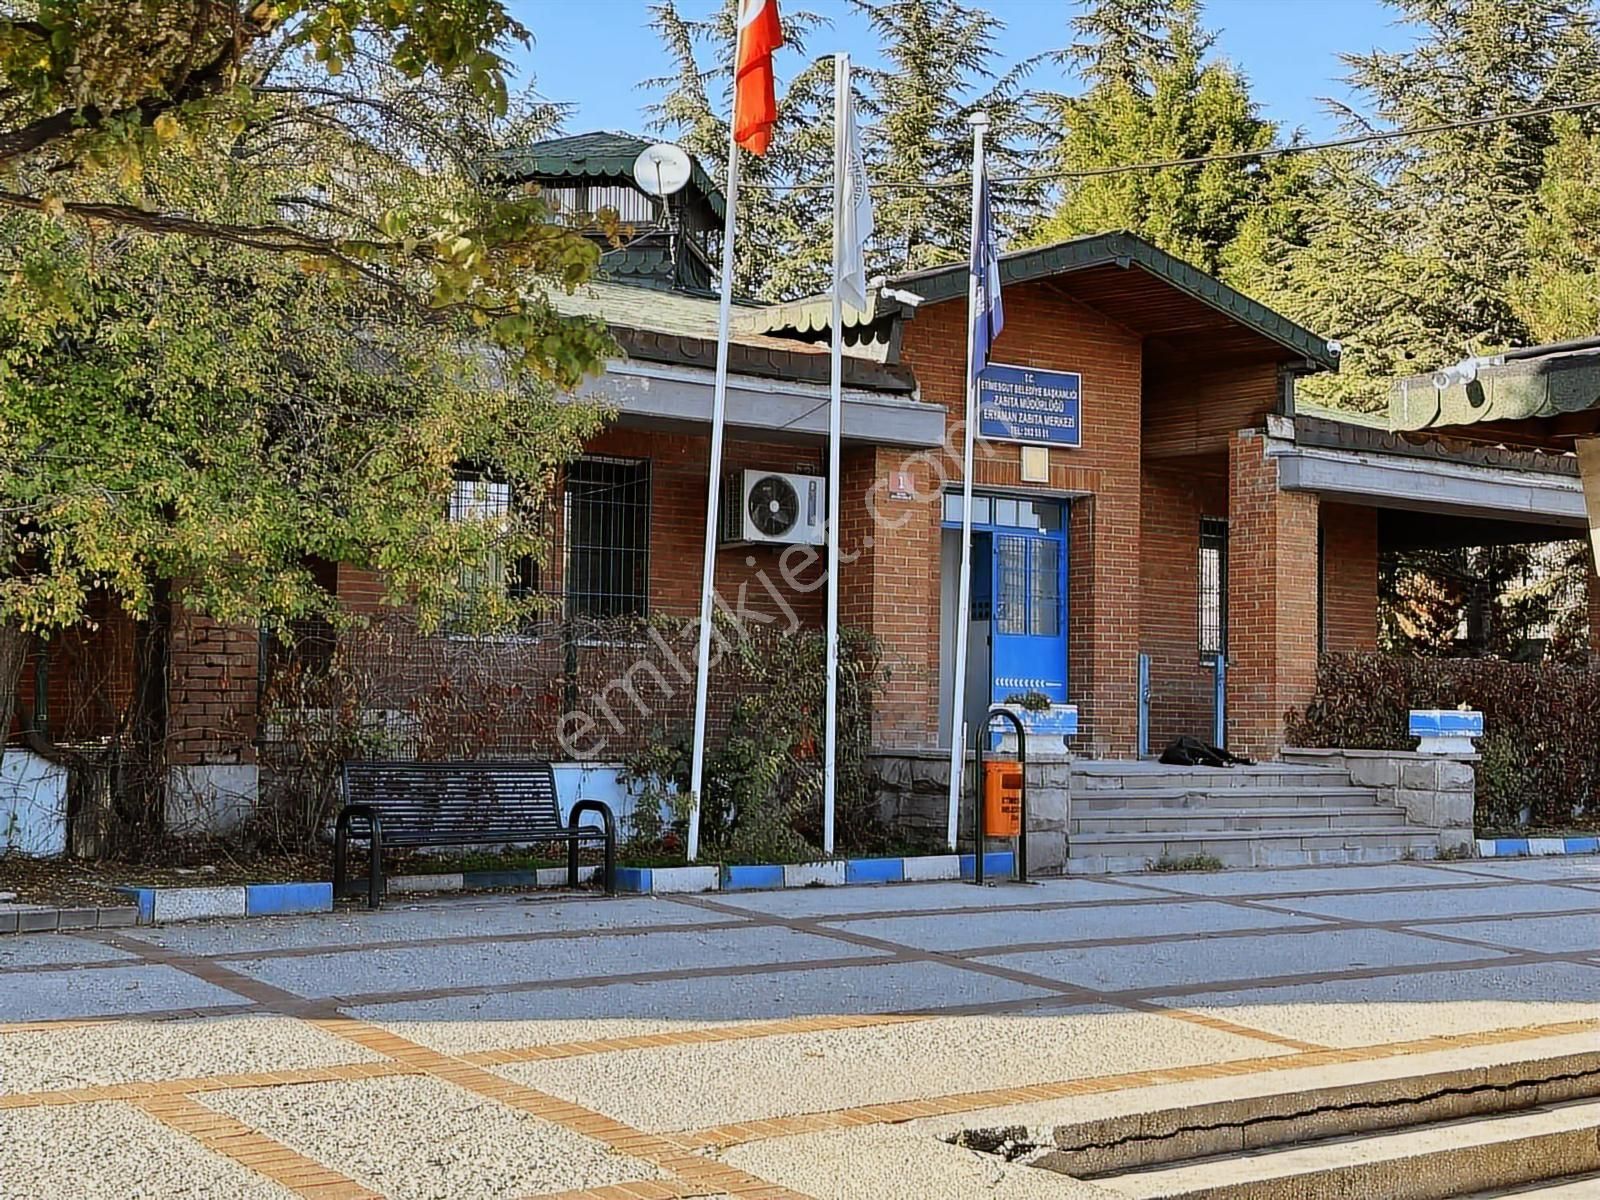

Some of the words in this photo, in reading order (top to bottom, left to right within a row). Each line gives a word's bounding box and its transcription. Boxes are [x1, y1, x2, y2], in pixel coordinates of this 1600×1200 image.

[1014, 384, 1042, 397] BELEDİYE
[994, 395, 1019, 408] ZABITA
[984, 409, 1018, 423] ERYAMAN
[1018, 412, 1043, 426] ZABITA
[1043, 415, 1075, 428] MERKEZİ
